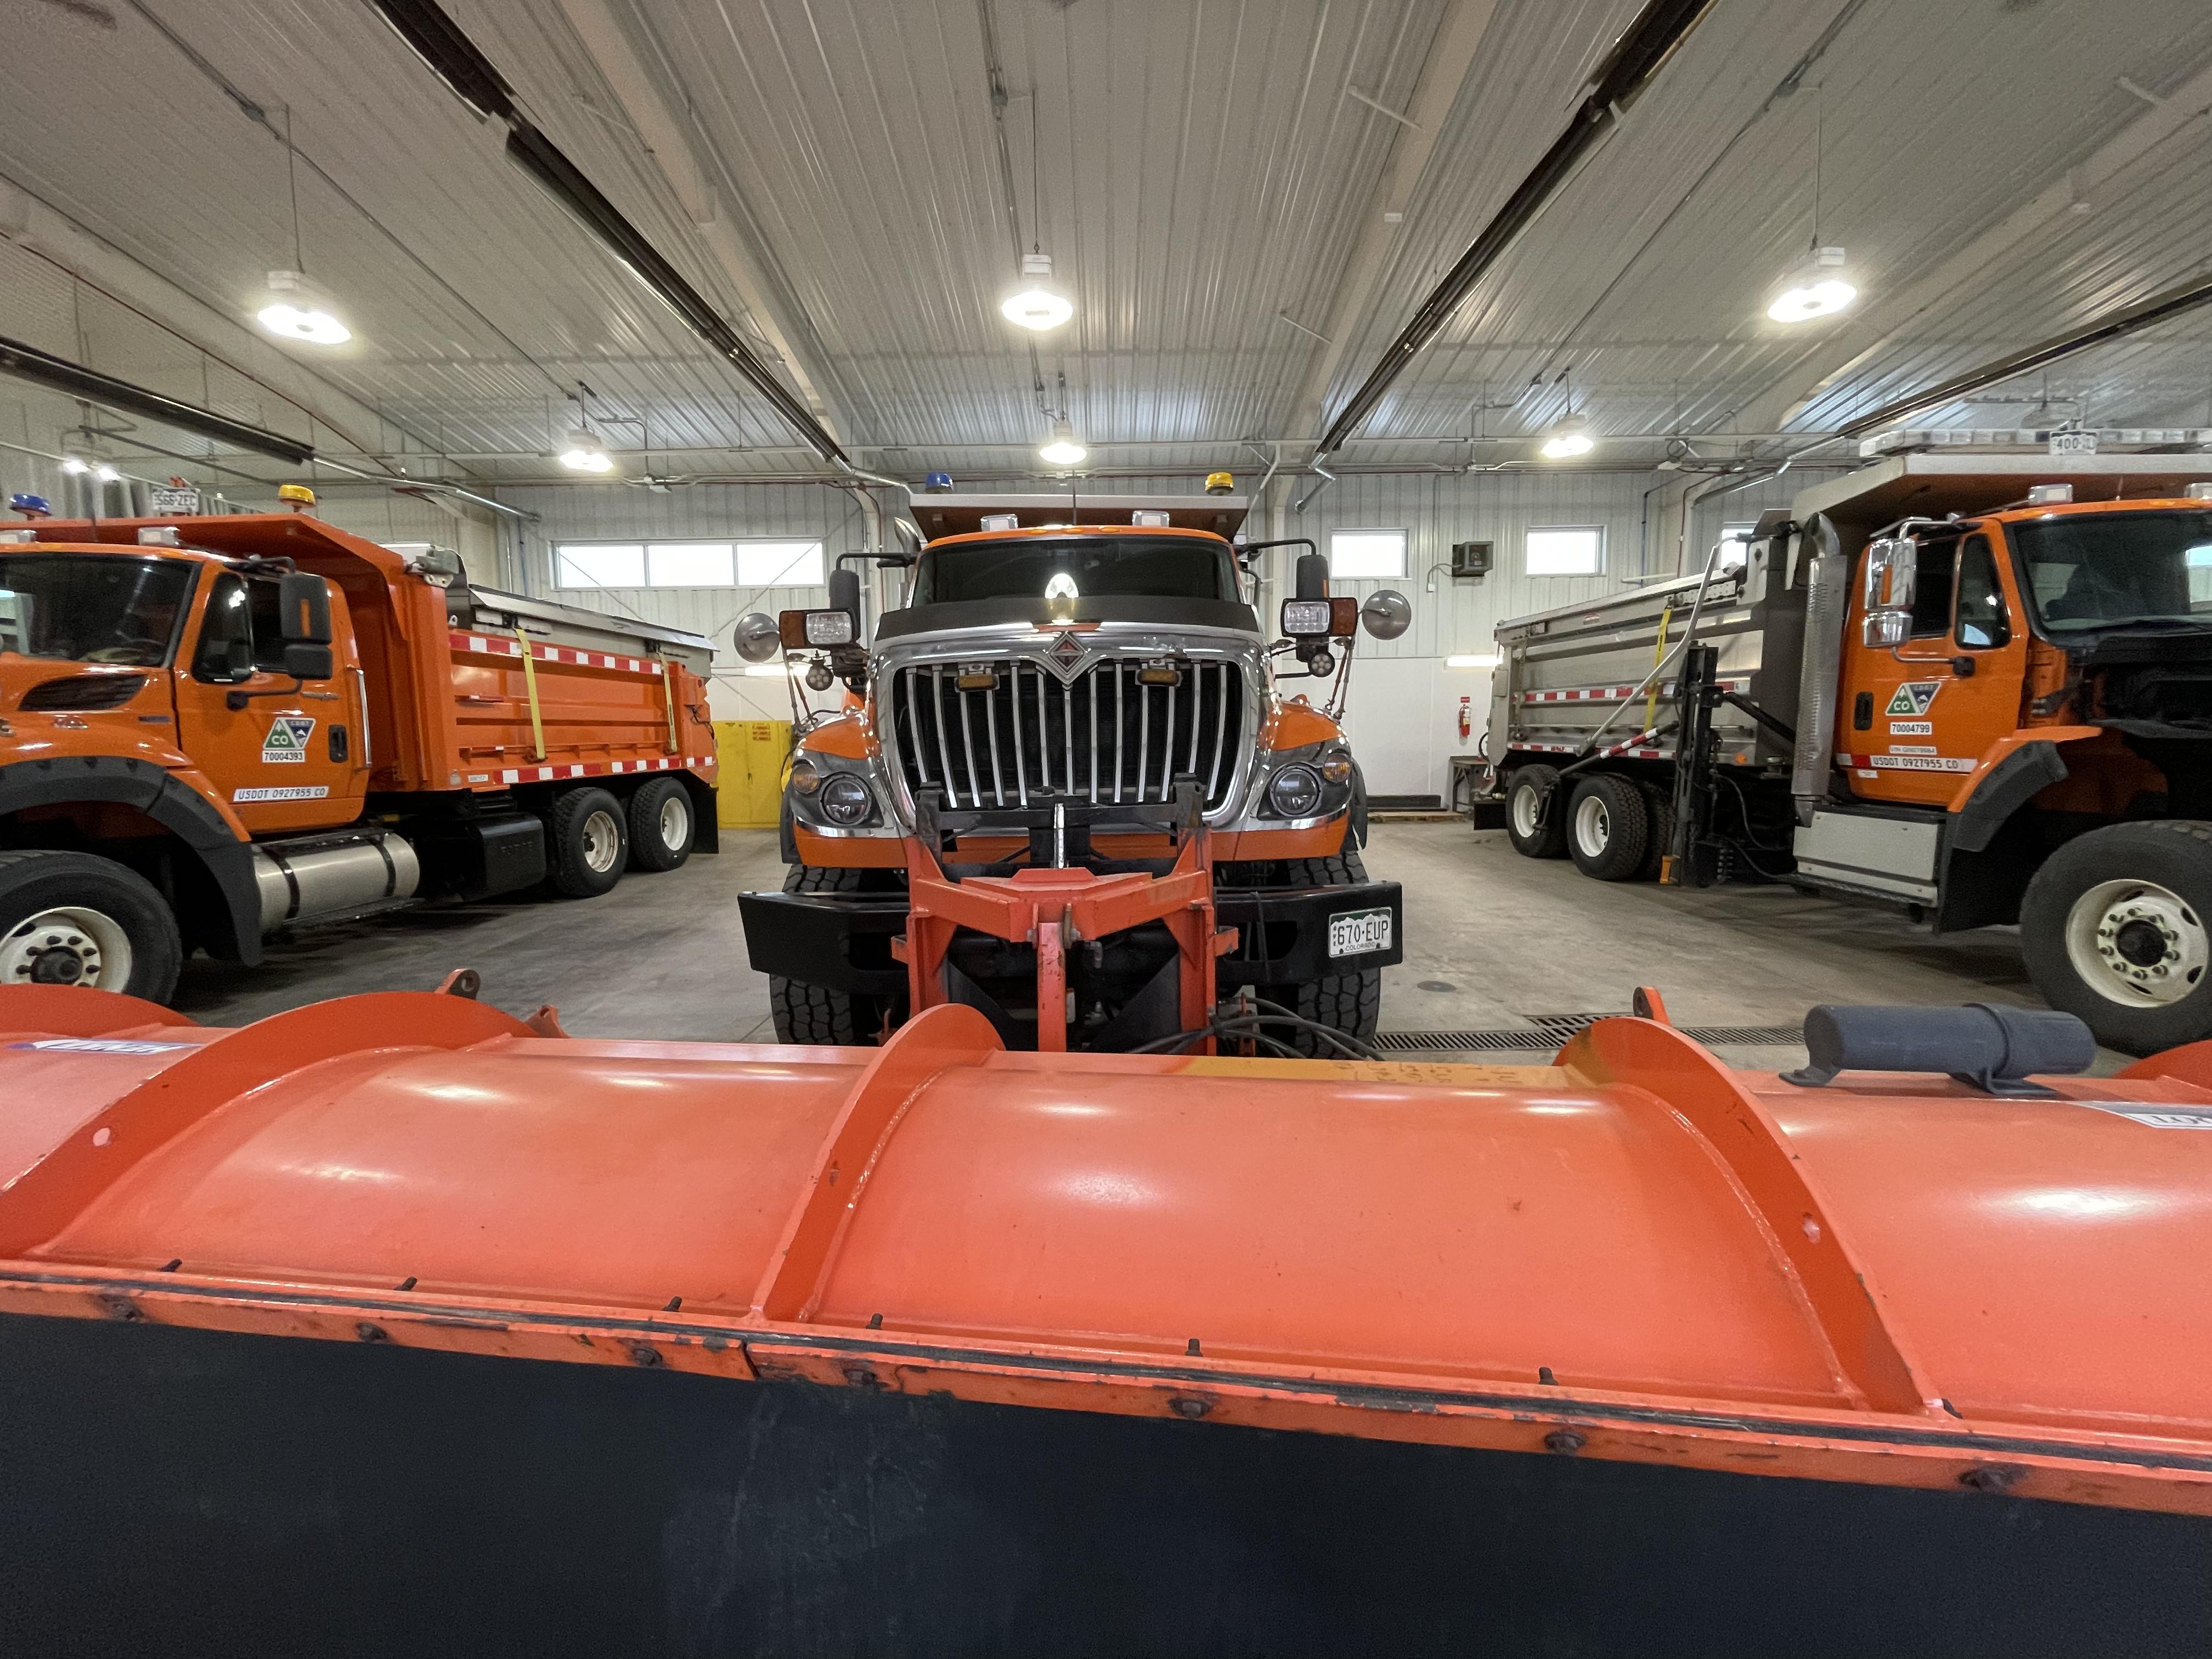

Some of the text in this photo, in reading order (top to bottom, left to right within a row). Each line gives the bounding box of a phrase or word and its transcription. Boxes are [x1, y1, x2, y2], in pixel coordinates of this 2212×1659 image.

[1893, 701, 1910, 711] CO
[1892, 724, 1930, 733] 70004799
[272, 735, 289, 744] CO
[264, 752, 303, 761] 70004393
[1874, 758, 1959, 769] USDOT 0927955 CO
[238, 788, 325, 800] USDOT 0927955 CO
[1345, 941, 1375, 951] COLORADO
